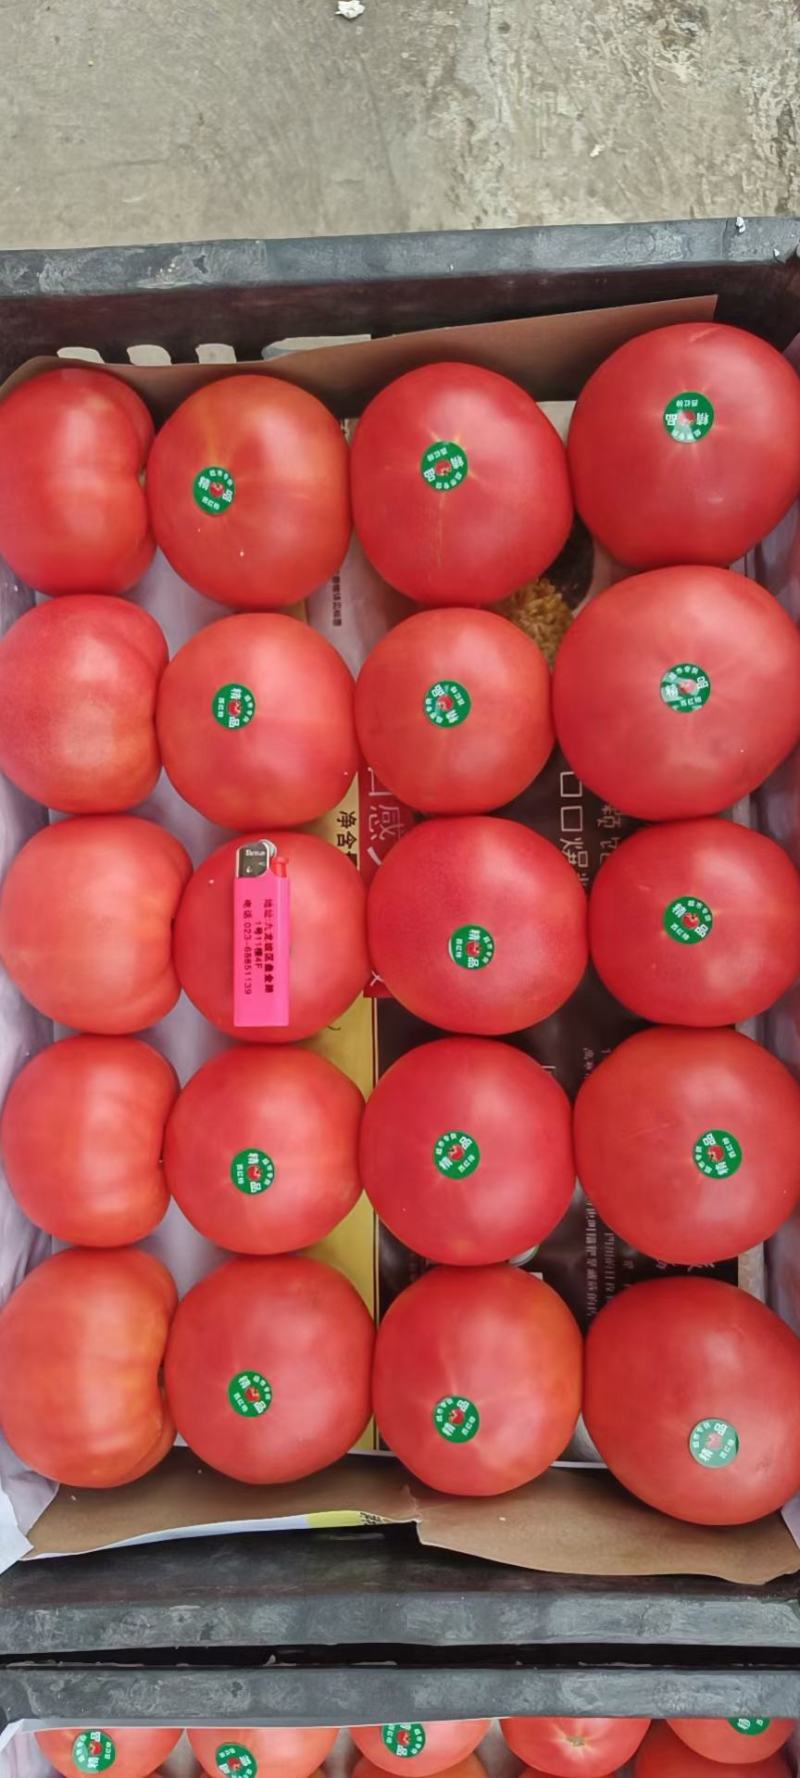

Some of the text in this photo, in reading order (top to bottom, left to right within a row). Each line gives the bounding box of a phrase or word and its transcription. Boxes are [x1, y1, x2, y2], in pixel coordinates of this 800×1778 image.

[664, 412, 708, 426] 精品
[422, 454, 464, 482] 精品
[197, 475, 233, 503] 精品
[430, 683, 460, 724] 精品
[664, 675, 709, 697] 精品
[228, 688, 241, 727] 精品
[670, 901, 708, 938] 精品
[467, 929, 480, 967] 精品
[247, 1152, 261, 1192] 精品
[437, 1135, 473, 1171] 精品
[701, 1132, 729, 1175] 精品
[237, 1374, 266, 1414] 精品
[440, 1398, 470, 1437] 精品
[697, 1421, 728, 1462] 精品
